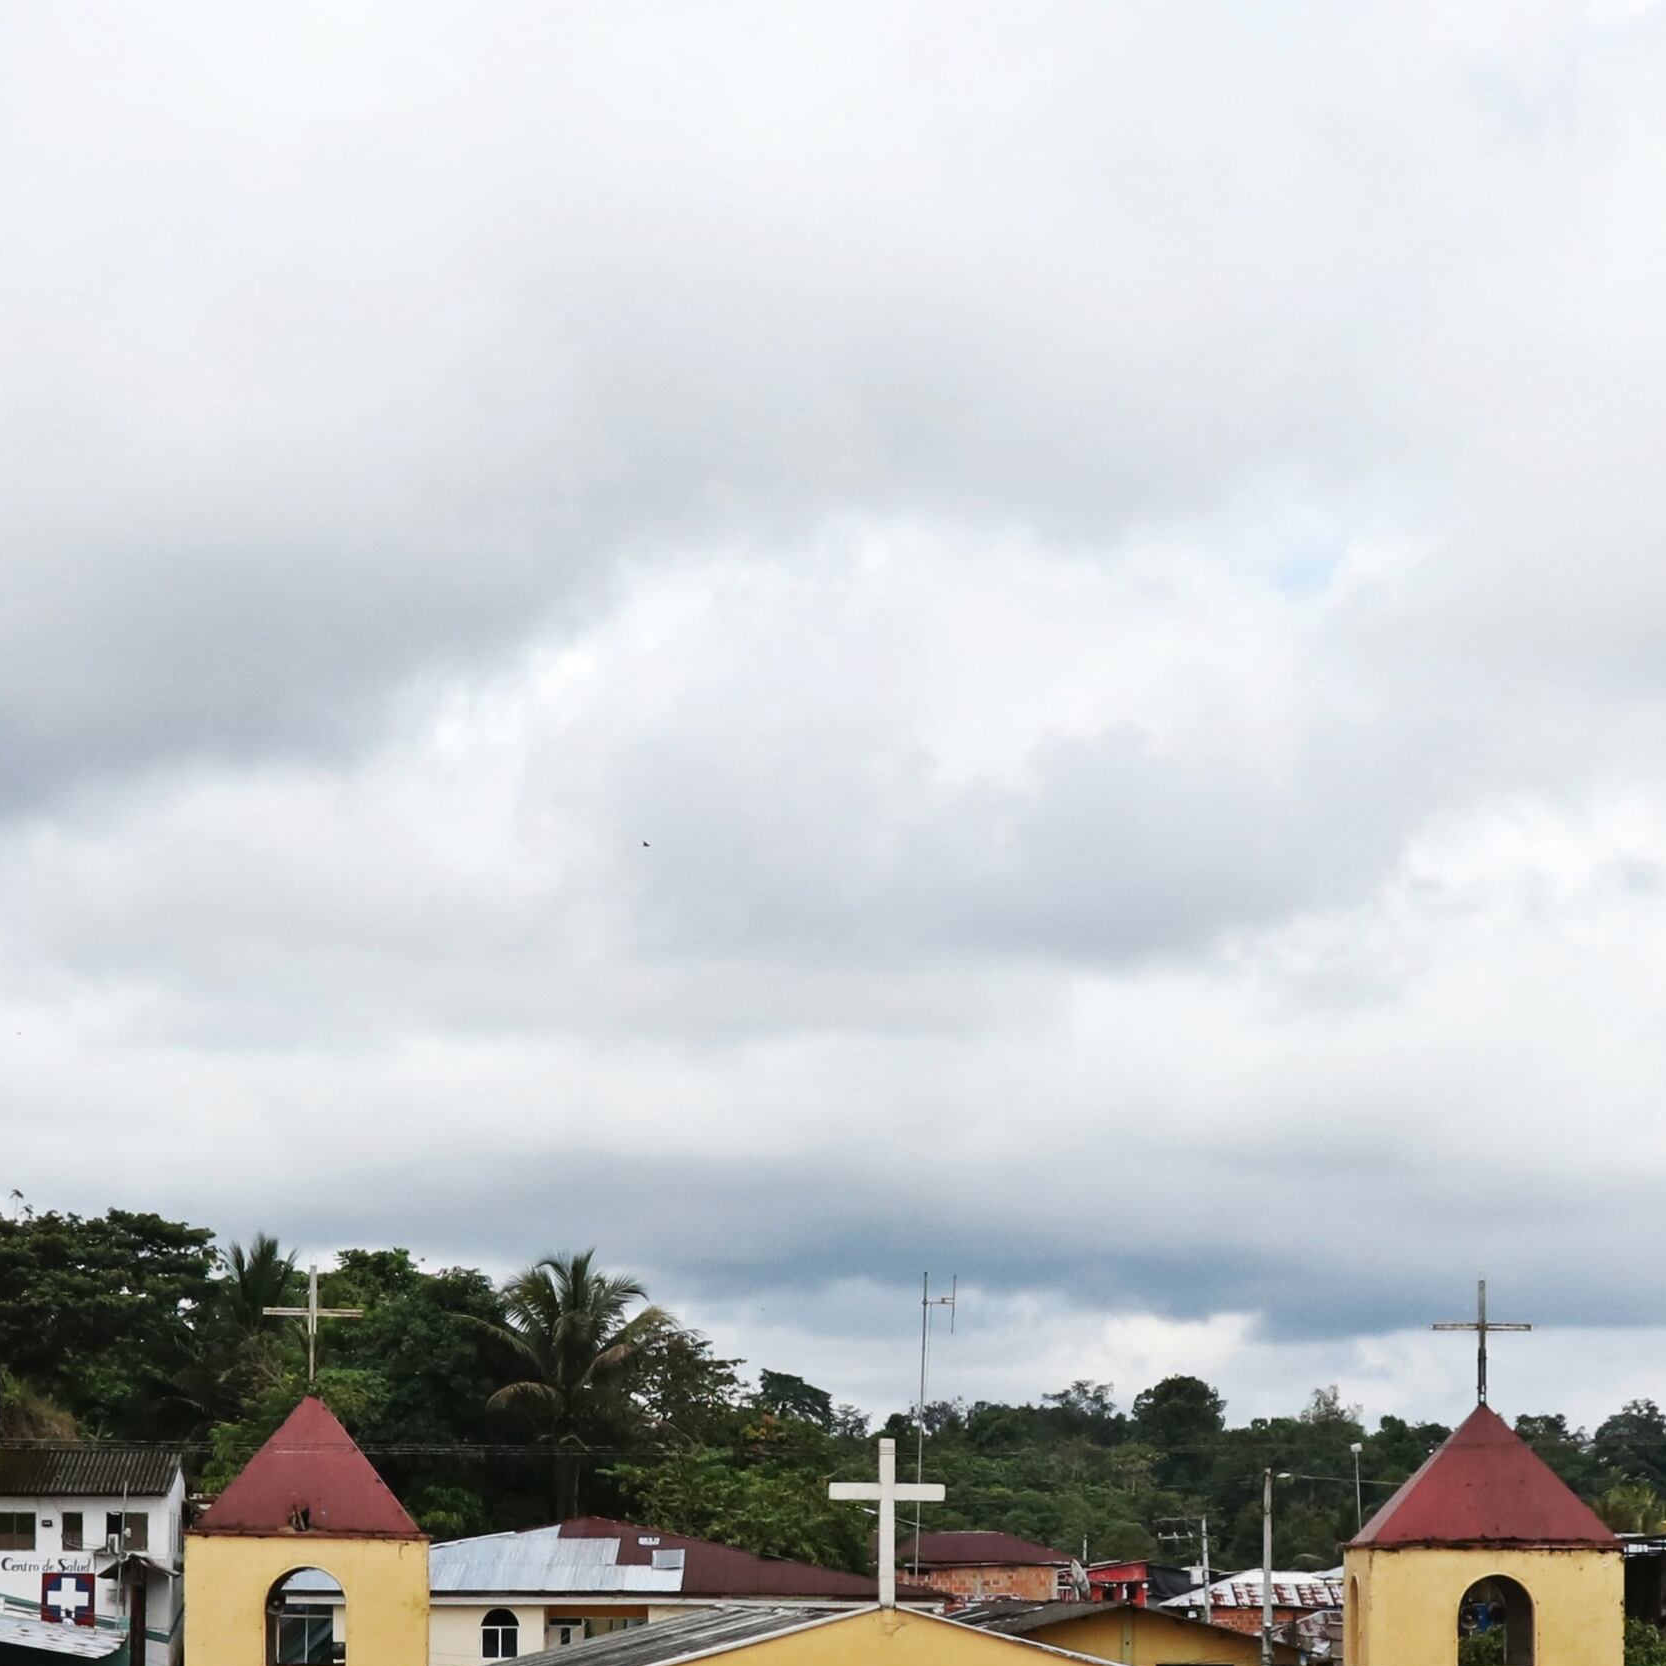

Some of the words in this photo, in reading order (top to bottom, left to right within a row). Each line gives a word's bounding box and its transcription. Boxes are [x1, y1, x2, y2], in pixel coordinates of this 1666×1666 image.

[1, 1557, 39, 1572] Centro
[42, 1558, 55, 1572] de
[57, 1557, 91, 1572] Salud
